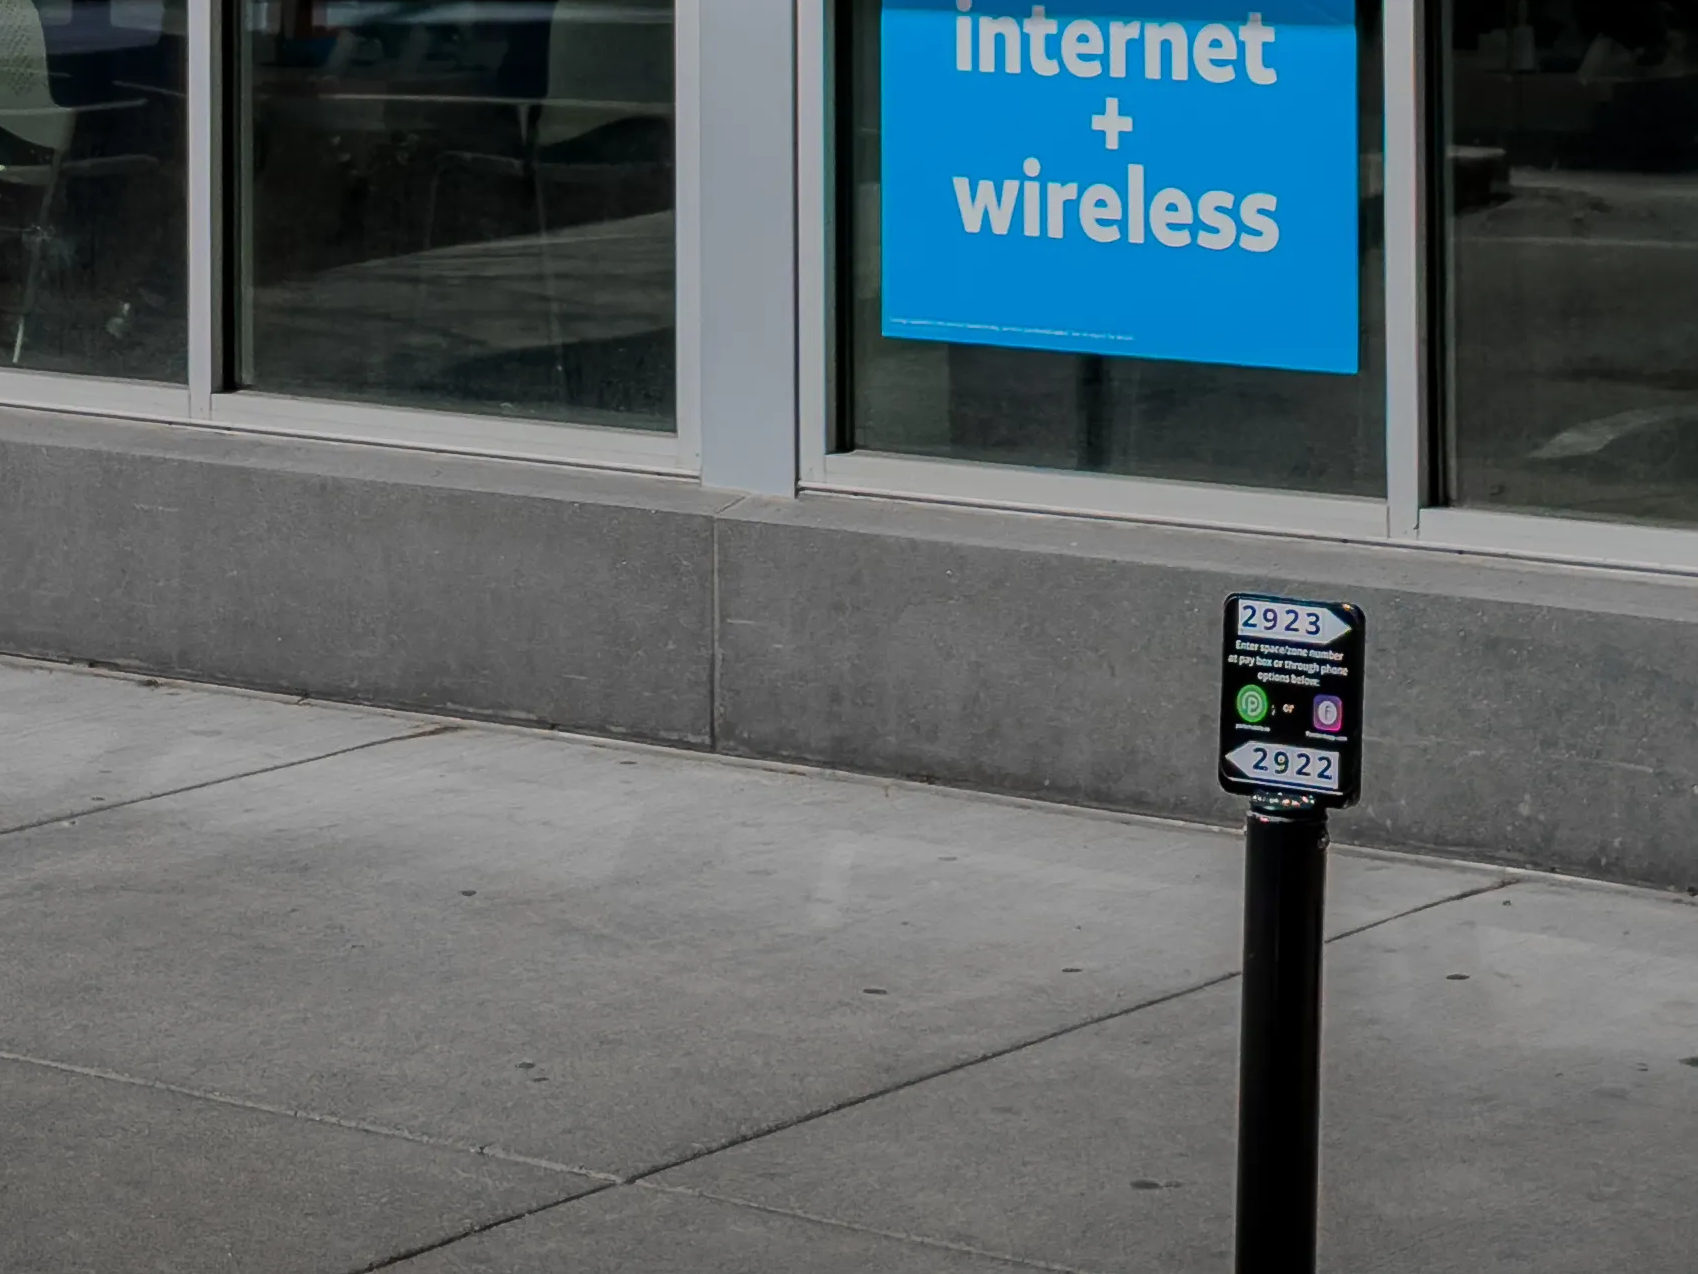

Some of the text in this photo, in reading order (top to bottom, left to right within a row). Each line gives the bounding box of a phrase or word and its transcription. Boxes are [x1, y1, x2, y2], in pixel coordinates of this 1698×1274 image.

[952, 156, 1280, 253] wireless
[1241, 604, 1321, 636] 2923
[1235, 639, 1259, 651] Enter
[1309, 649, 1345, 661] number
[1227, 654, 1348, 676] at pay box or through phone
[1257, 671, 1289, 683] options
[1282, 703, 1295, 713] or
[1252, 747, 1333, 781] 2922
